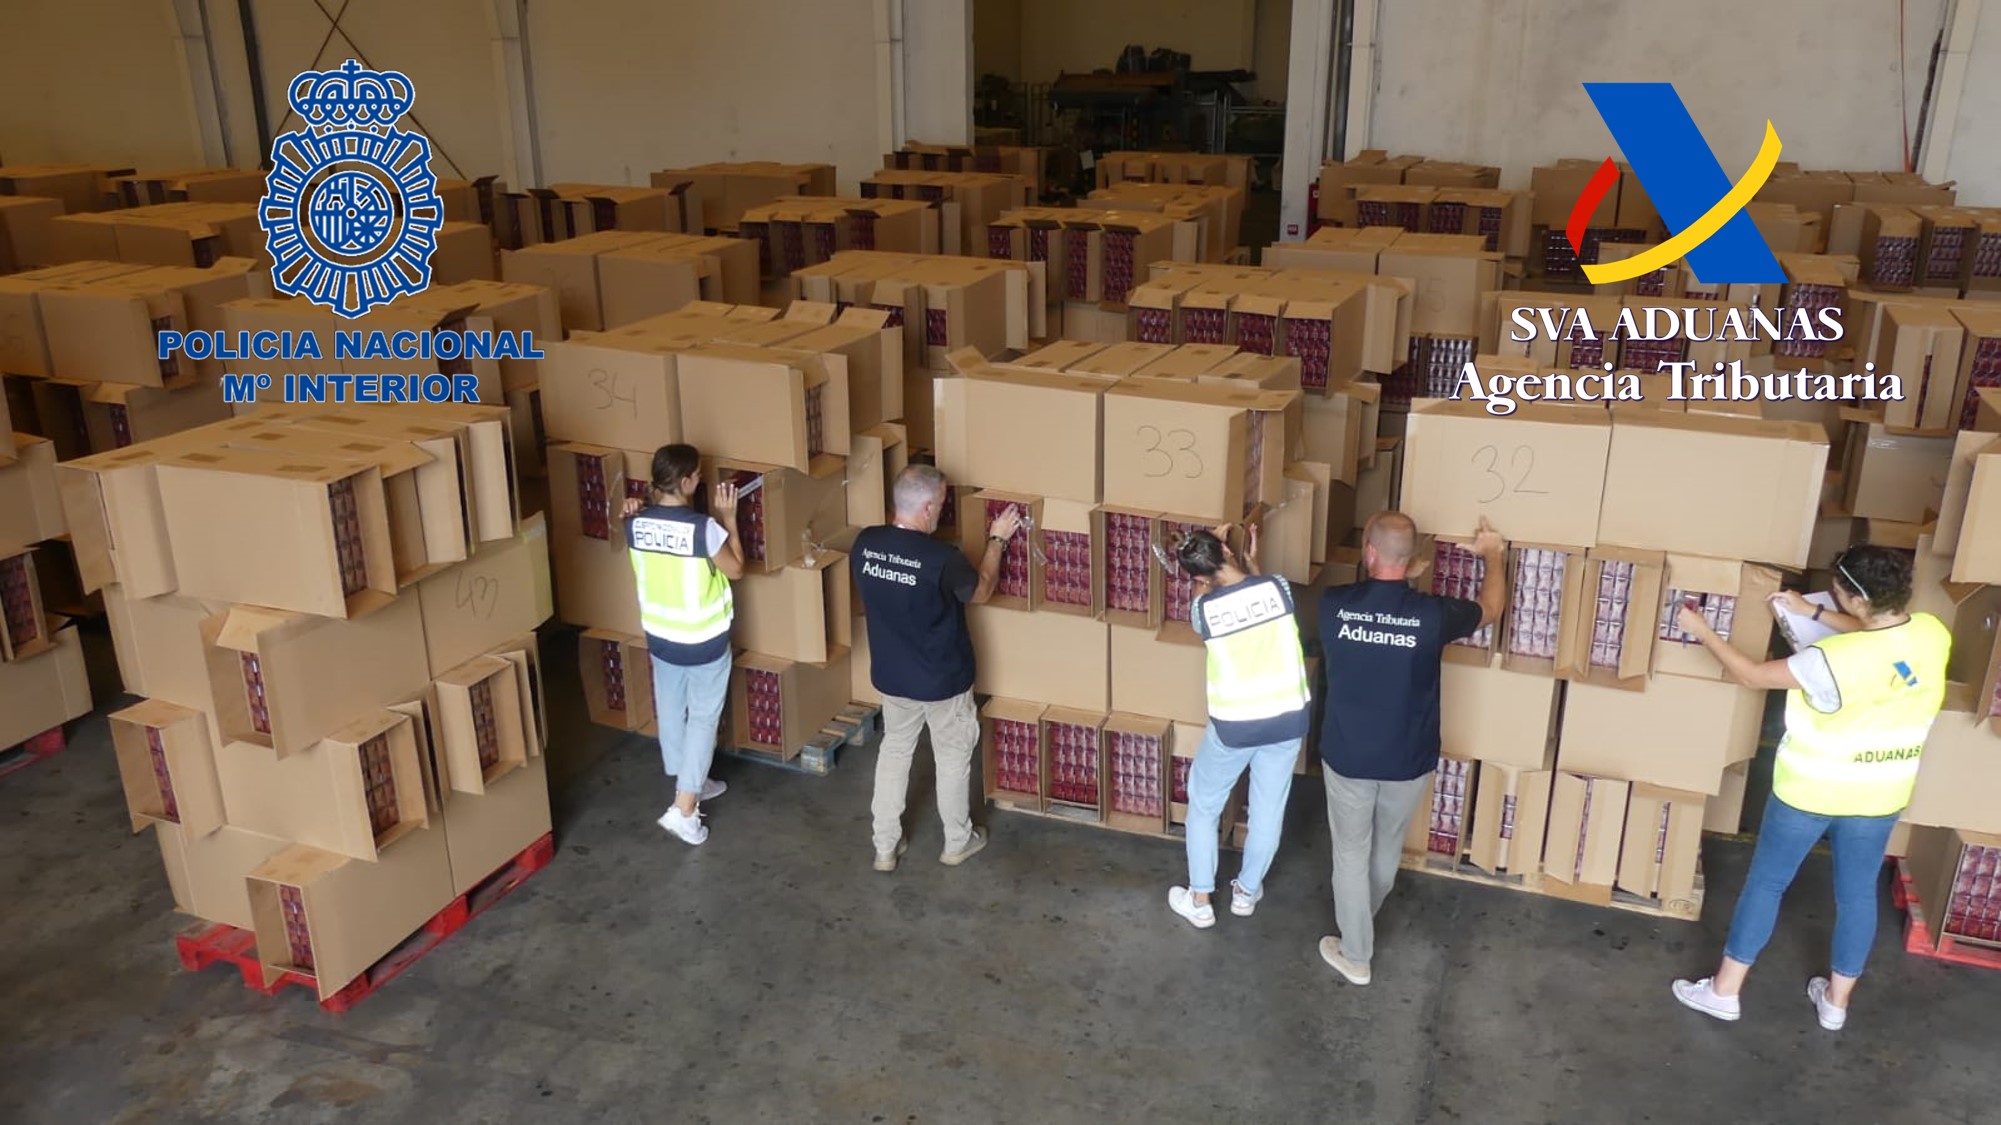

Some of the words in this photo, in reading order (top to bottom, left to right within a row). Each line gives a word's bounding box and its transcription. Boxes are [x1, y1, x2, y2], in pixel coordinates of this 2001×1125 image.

[587, 367, 638, 420] 34
[1136, 424, 1204, 479] 33
[1471, 444, 1552, 504] 32
[635, 531, 689, 551] POLICIA
[862, 547, 887, 561] Agencia
[862, 561, 917, 586] Aduanas
[1336, 608, 1373, 622] Agencia
[1375, 612, 1421, 627] Tributaria
[1337, 623, 1418, 648] Aduanas
[1854, 745, 1921, 763] ADUANAS
